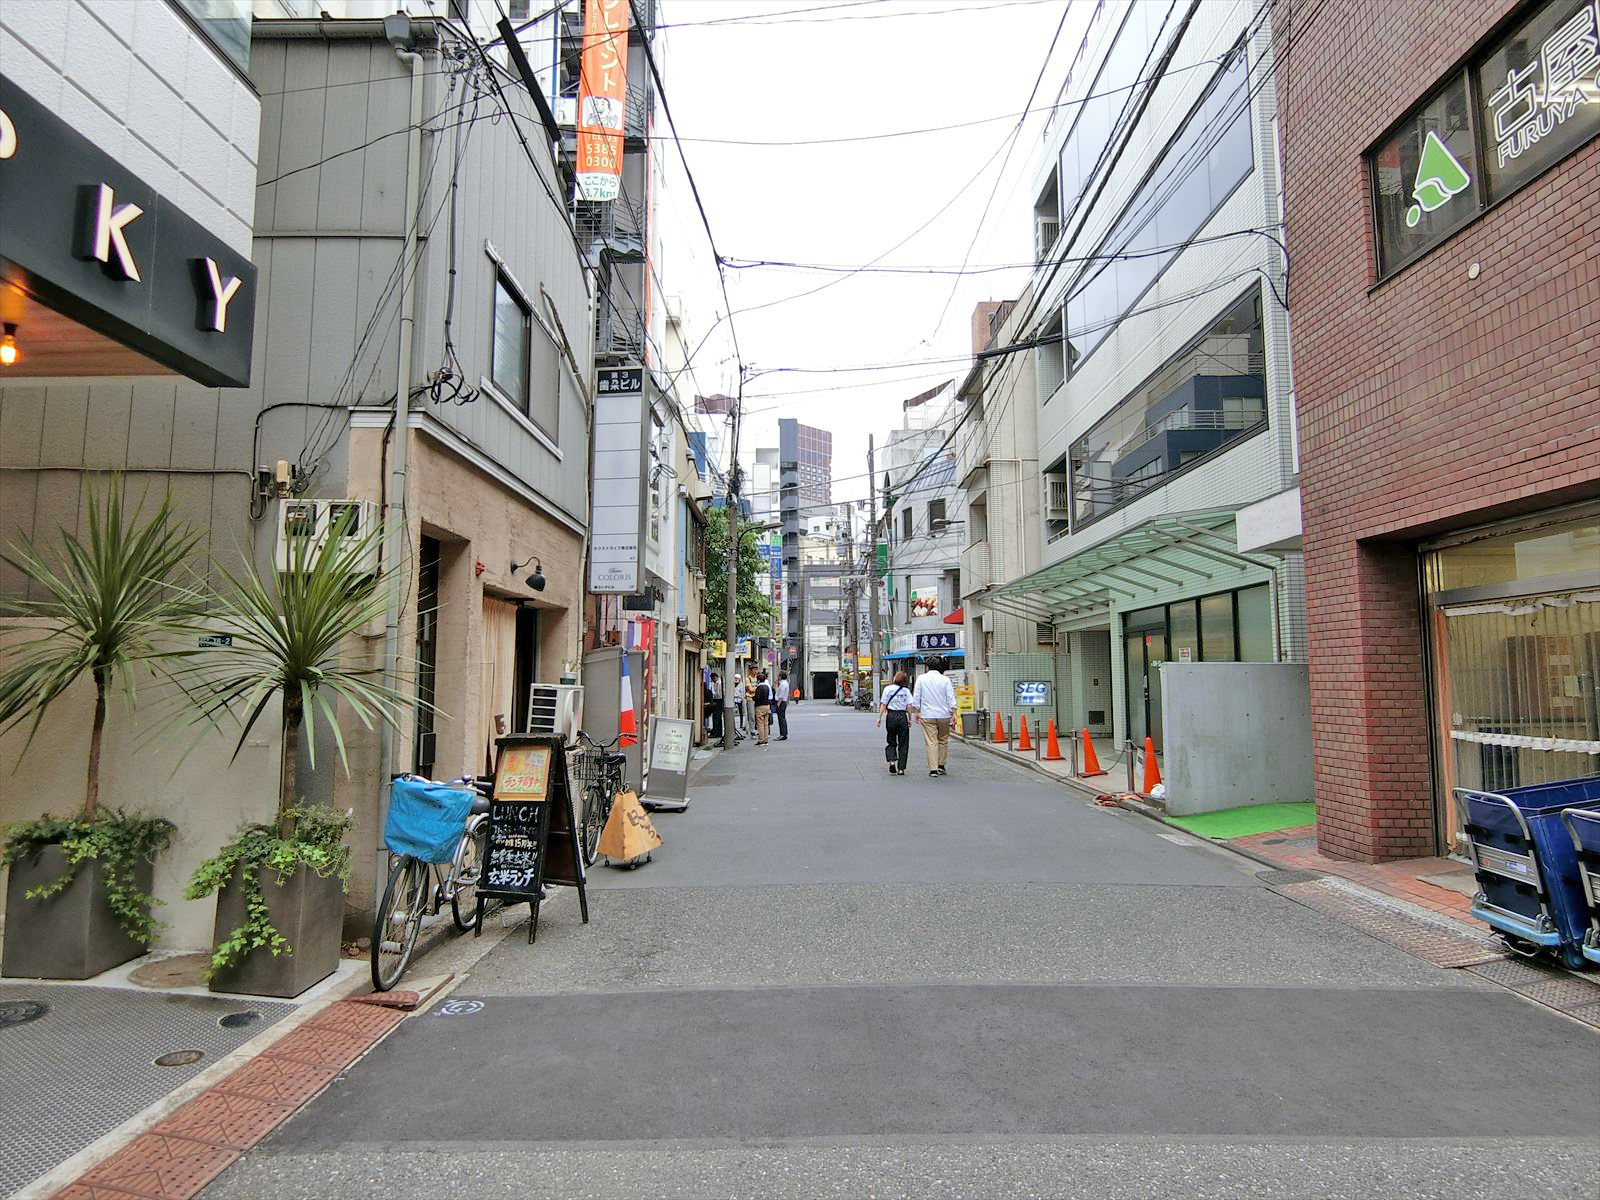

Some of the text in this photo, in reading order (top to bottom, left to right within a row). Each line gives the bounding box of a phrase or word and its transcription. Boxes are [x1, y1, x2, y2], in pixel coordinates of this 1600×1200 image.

[1488, 0, 1600, 141] 古屋
[1498, 87, 1590, 168] FURUYA
[586, 143, 617, 155] 5385
[585, 176, 617, 187] ここから
[1015, 682, 1046, 694] SEG
[493, 805, 539, 823] LUNCH
[488, 867, 535, 887] 玄米ランチ
